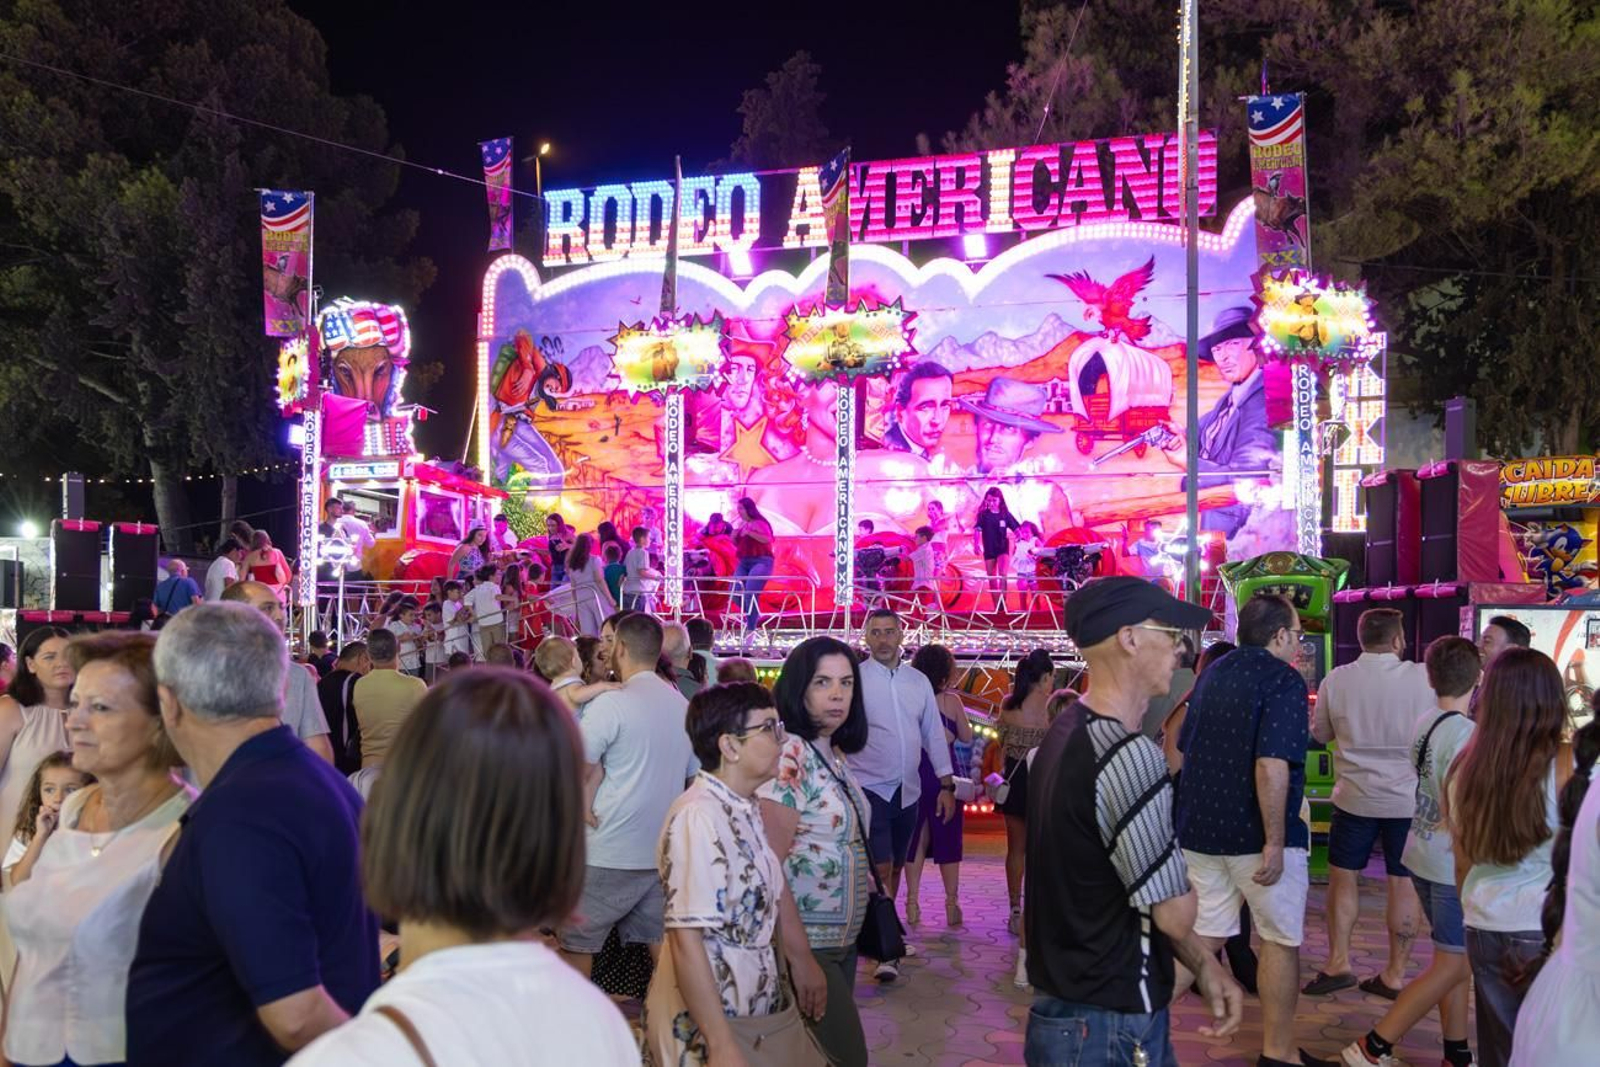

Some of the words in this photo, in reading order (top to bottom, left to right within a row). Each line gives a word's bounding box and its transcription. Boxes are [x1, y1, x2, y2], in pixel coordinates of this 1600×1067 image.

[543, 173, 761, 267] RODEO
[783, 130, 1217, 249] AMERICANO
[668, 396, 678, 453] RODEO
[838, 387, 849, 447] RODEO
[1299, 364, 1310, 431] RODEO
[304, 411, 315, 465] RODEO
[1504, 459, 1595, 483] CAIDA
[1510, 480, 1589, 504] LIBRE
[303, 473, 314, 570] AMERICANO
[667, 463, 678, 567] AMERICANO
[837, 458, 849, 565] AMERICANO
